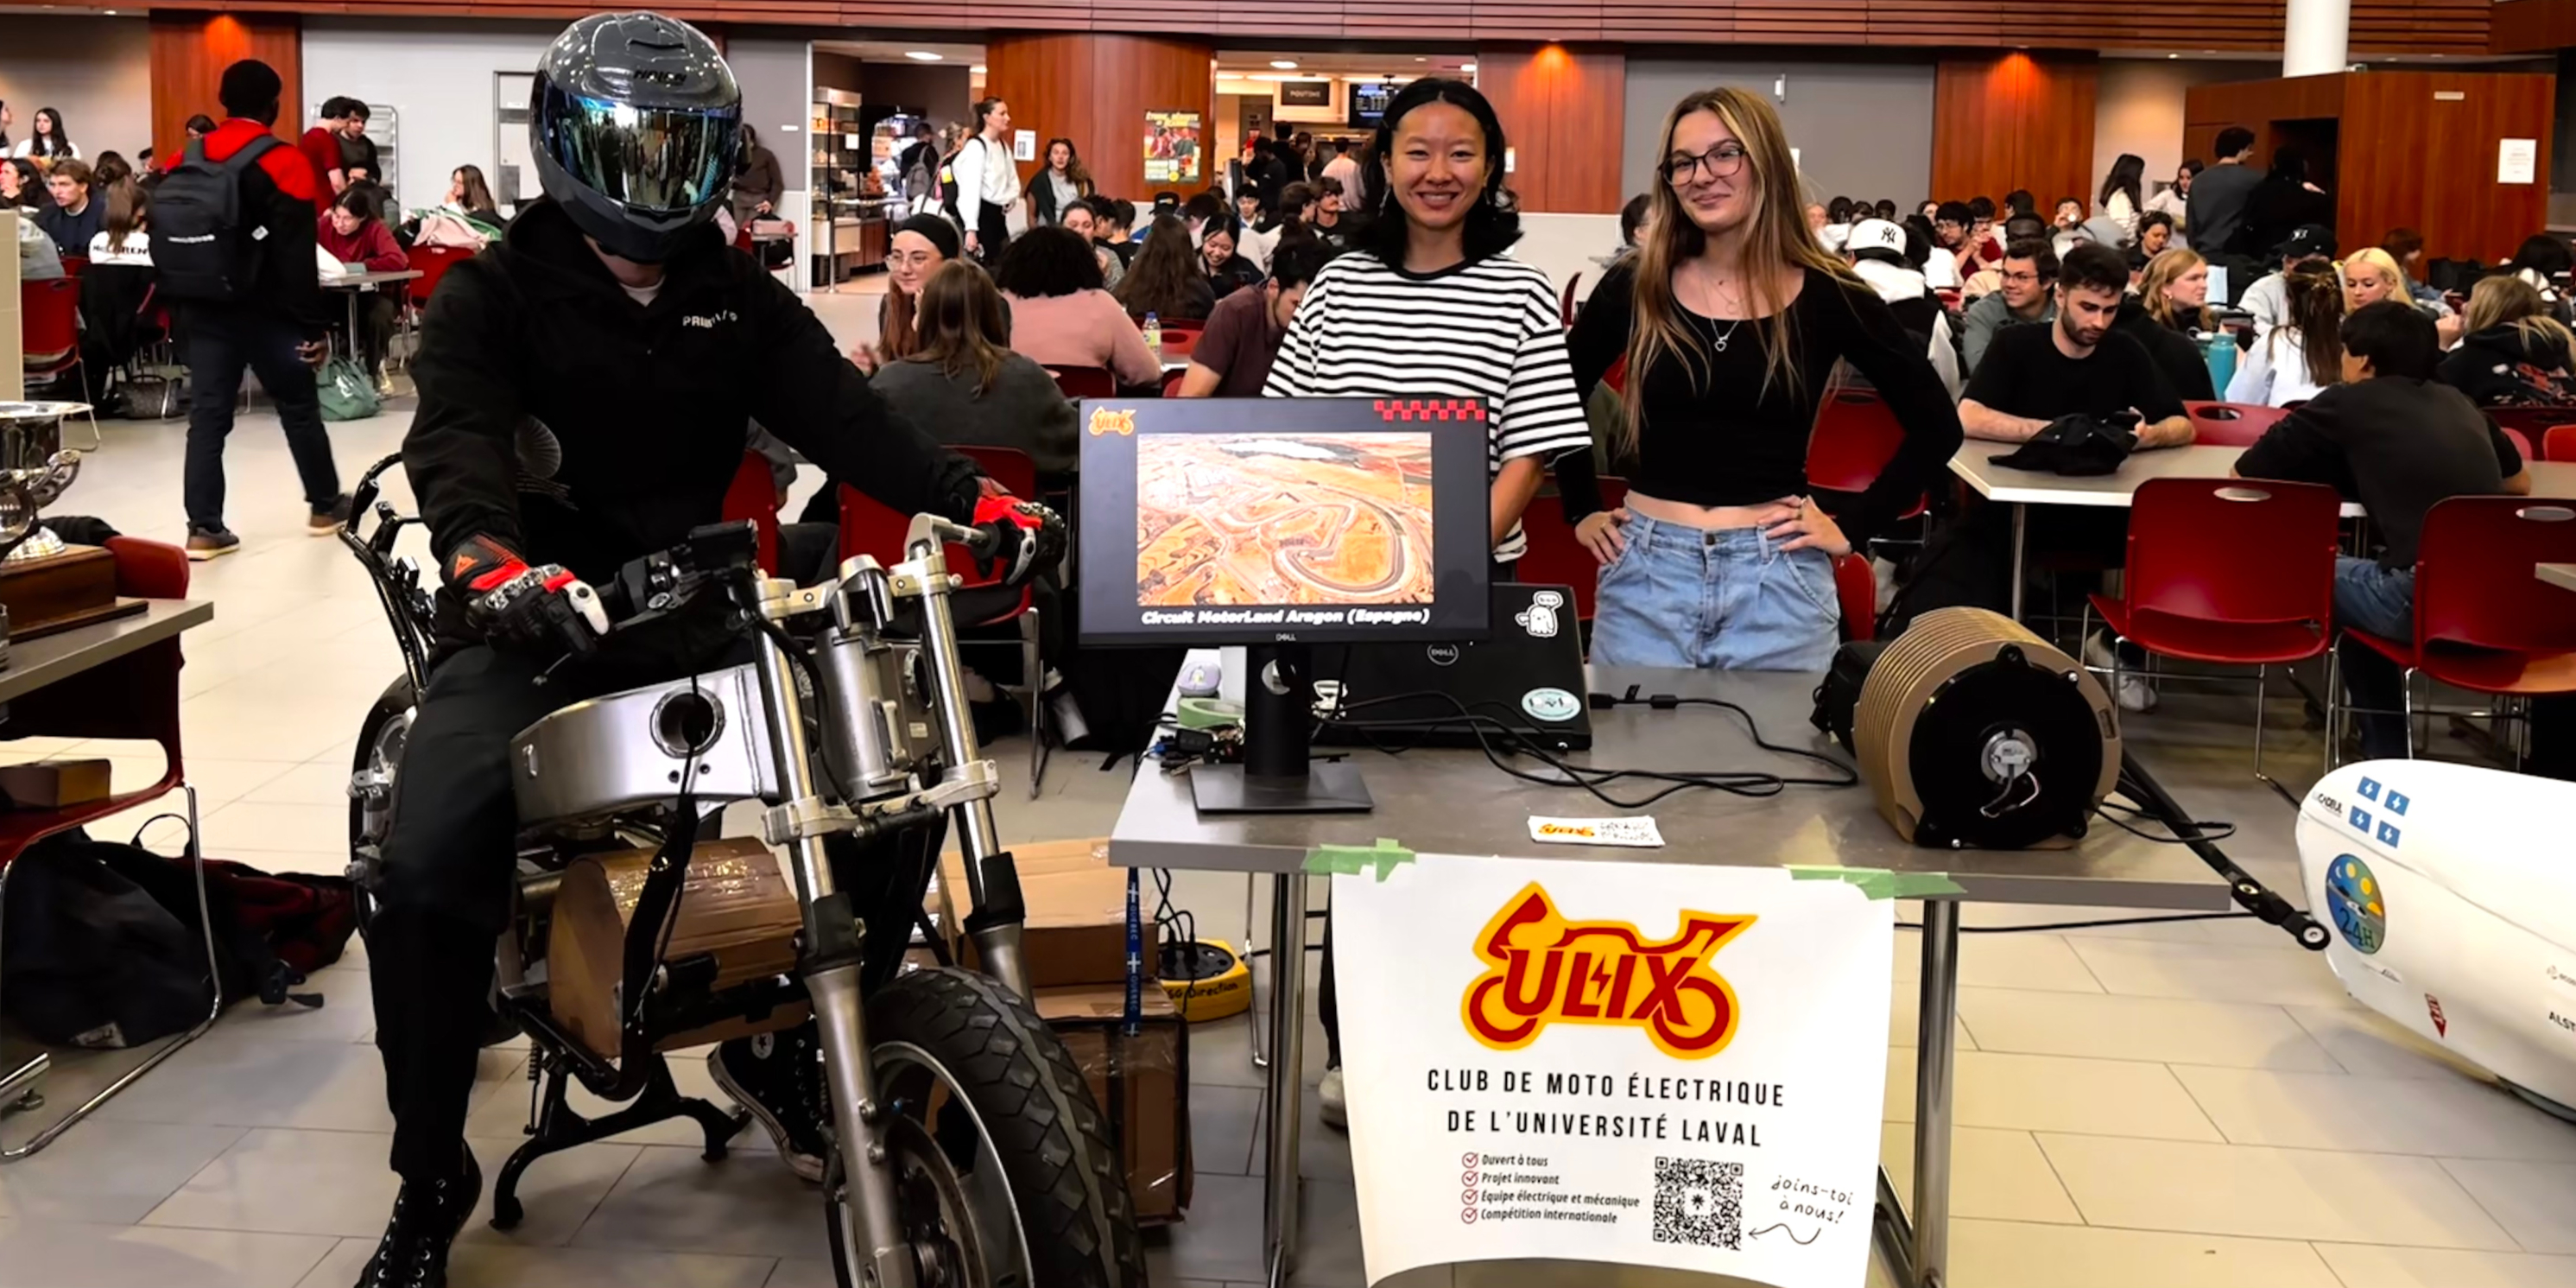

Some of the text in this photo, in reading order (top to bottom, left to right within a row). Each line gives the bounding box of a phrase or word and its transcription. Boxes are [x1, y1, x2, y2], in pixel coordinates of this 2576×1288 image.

[1141, 608, 1431, 625] Circuit MotorLand Aragon (Espagne)
[1275, 633, 1296, 642] DELL
[1431, 648, 1455, 657] DELL
[2339, 906, 2376, 950] 24H
[1187, 981, 1239, 999] Direction
[1503, 949, 1699, 1027] ULIX
[1427, 1069, 1784, 1107] CLUB DE MOTO ÉLECTRIQUE
[1447, 1110, 1762, 1147] DE L'UNIVERSITÉ LAVAL
[1482, 1153, 1548, 1166] Ouvert à tous
[1481, 1172, 1560, 1185] Projet innovant
[1481, 1190, 1641, 1209] Équipe électrique et mécanique
[1771, 1175, 1854, 1206] joins-toi
[1481, 1208, 1617, 1223] Compétition internationale
[1779, 1195, 1845, 1224] à nous!
